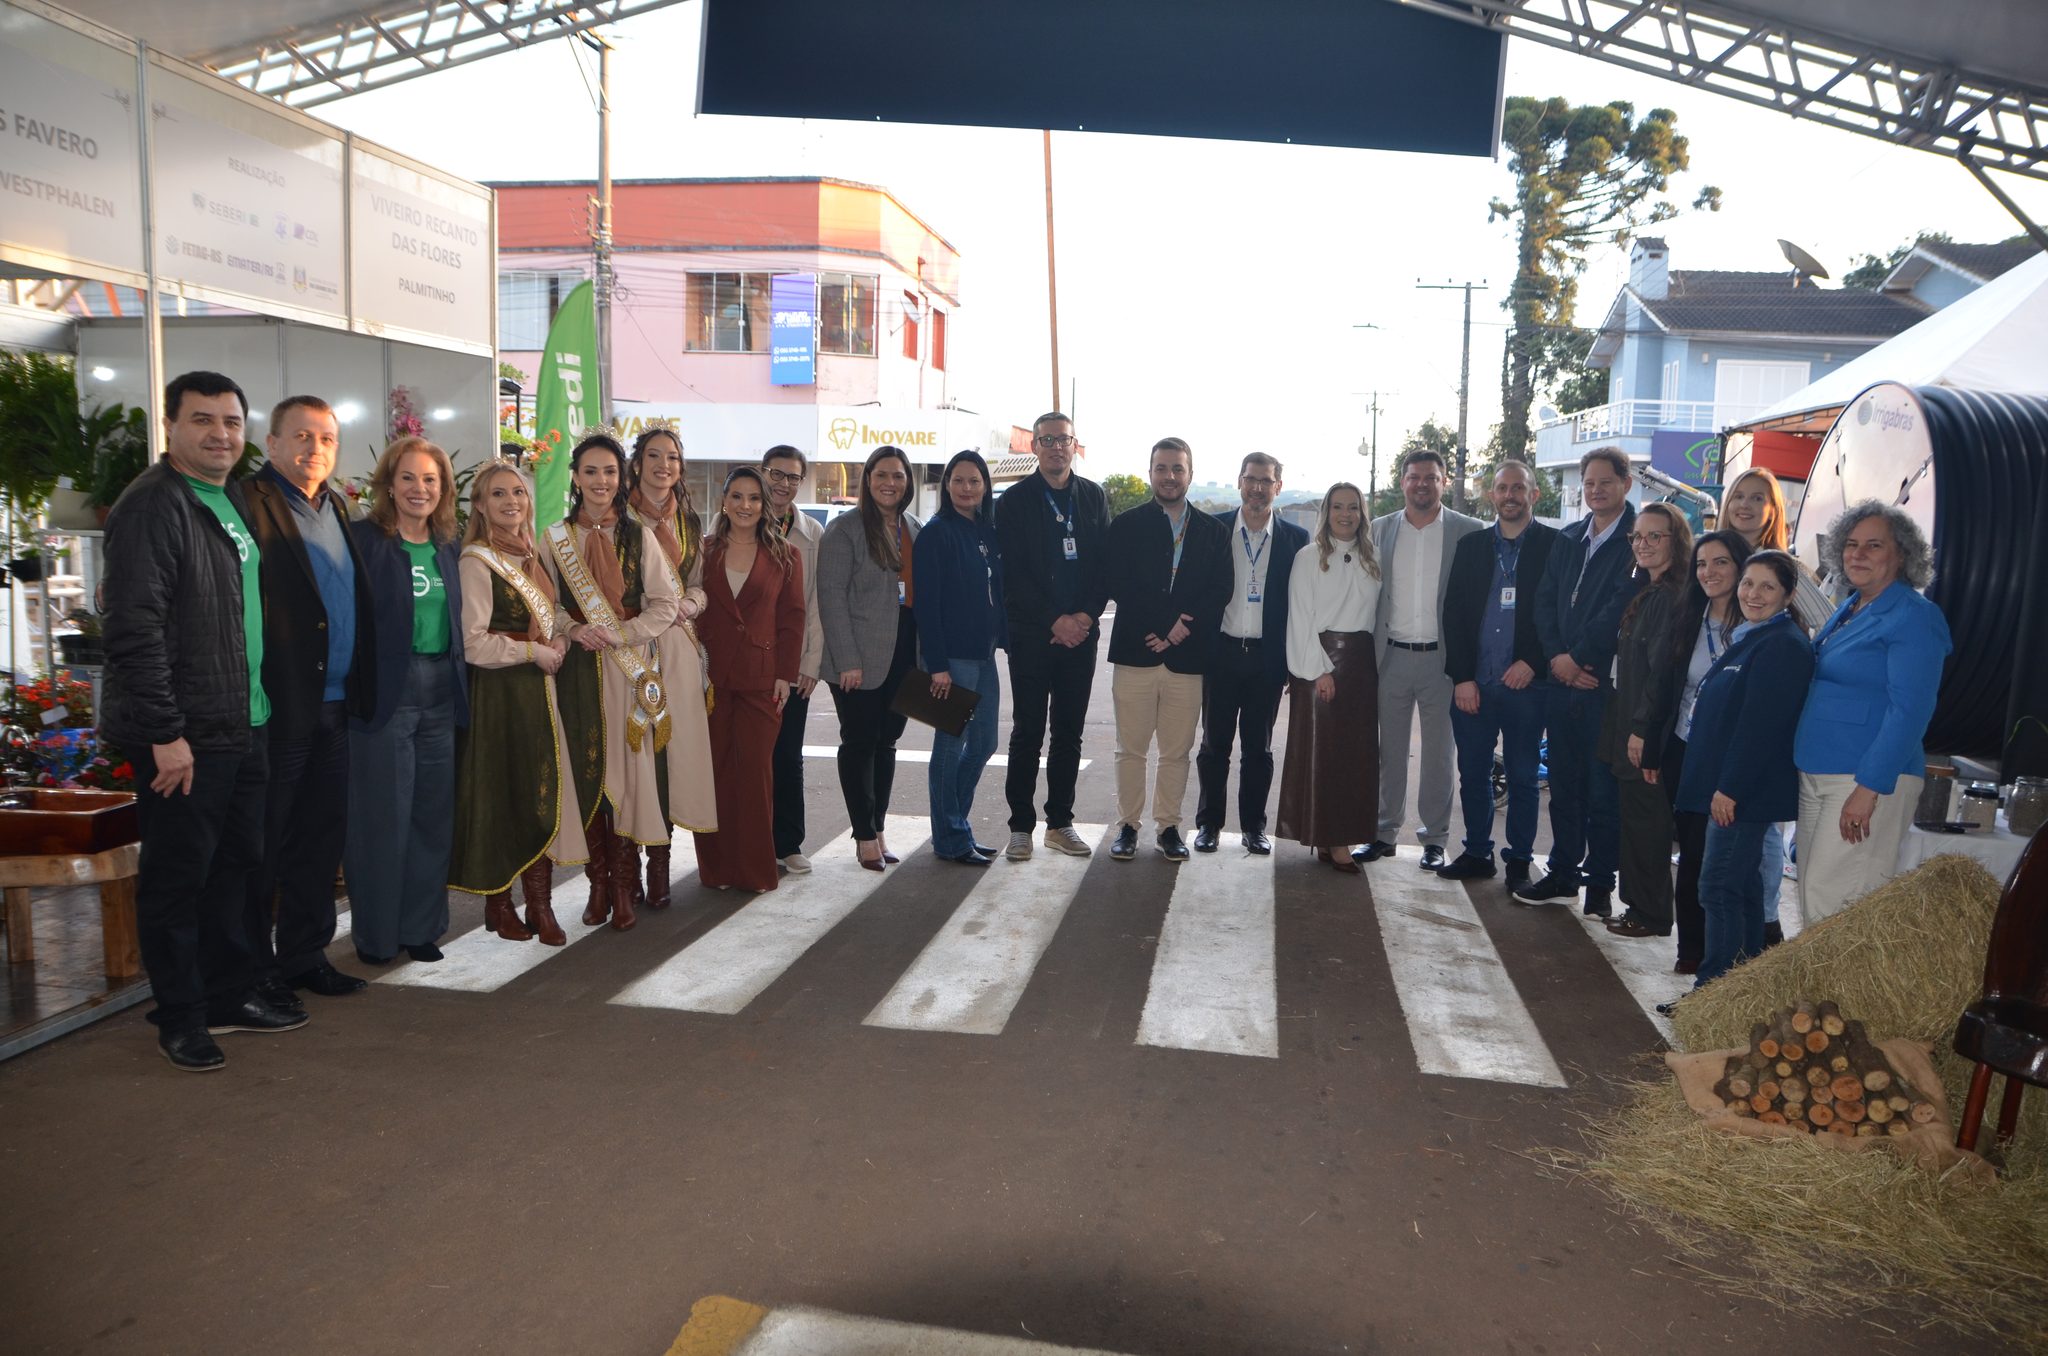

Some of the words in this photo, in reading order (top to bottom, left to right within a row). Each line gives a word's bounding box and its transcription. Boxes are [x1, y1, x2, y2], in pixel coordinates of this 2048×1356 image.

[14, 113, 98, 160] FAVERO
[227, 156, 286, 189] REALIZAÇÃO
[371, 193, 422, 227] VIVEIRO
[425, 214, 478, 247] RECANTO
[391, 231, 417, 256] DAS
[420, 241, 462, 270] FLORES
[398, 277, 456, 304] PALMITINHO
[862, 424, 937, 446] INOVARE
[1872, 402, 1915, 432] Irrigabras
[556, 537, 600, 604] RAINHA
